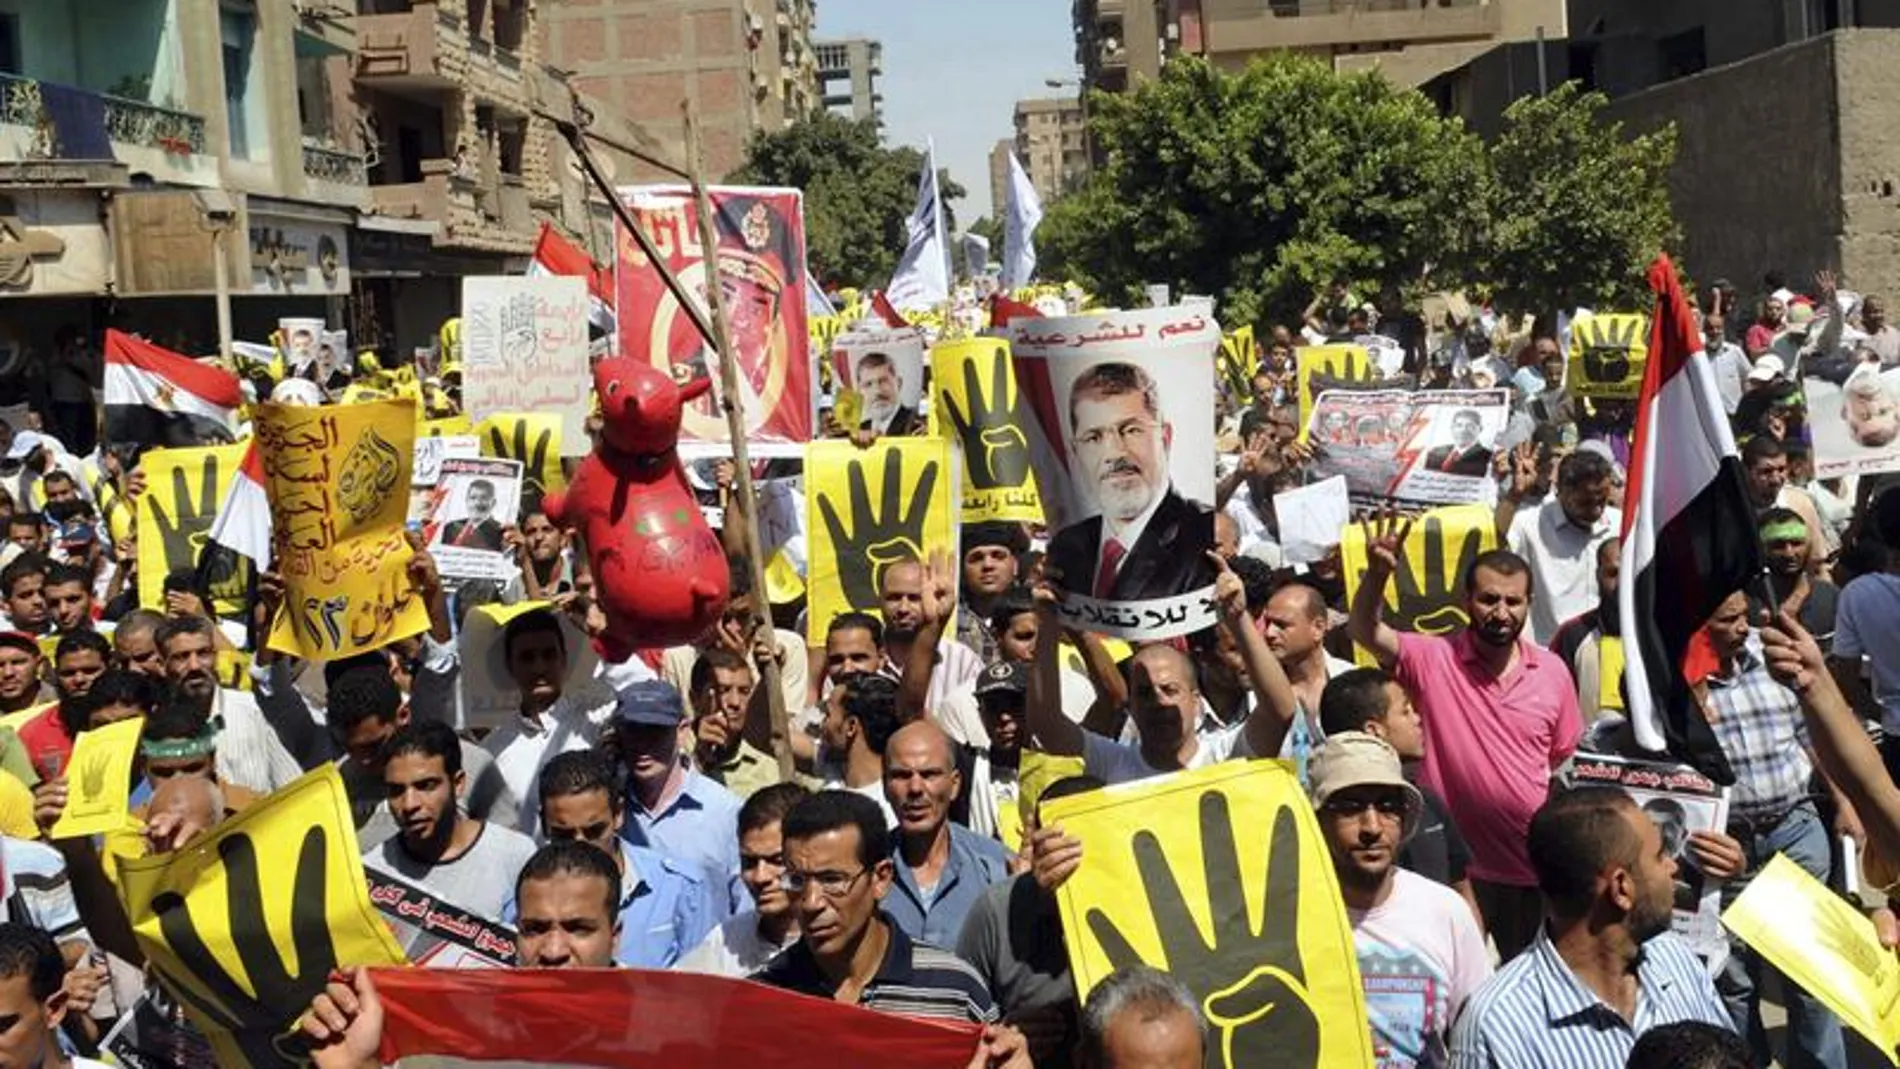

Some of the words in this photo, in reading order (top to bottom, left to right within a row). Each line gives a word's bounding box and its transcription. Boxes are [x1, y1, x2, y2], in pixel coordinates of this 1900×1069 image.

[1016, 320, 1146, 350] للشرعية
[1158, 315, 1206, 339] نعم
[1004, 489, 1037, 508] كلنا
